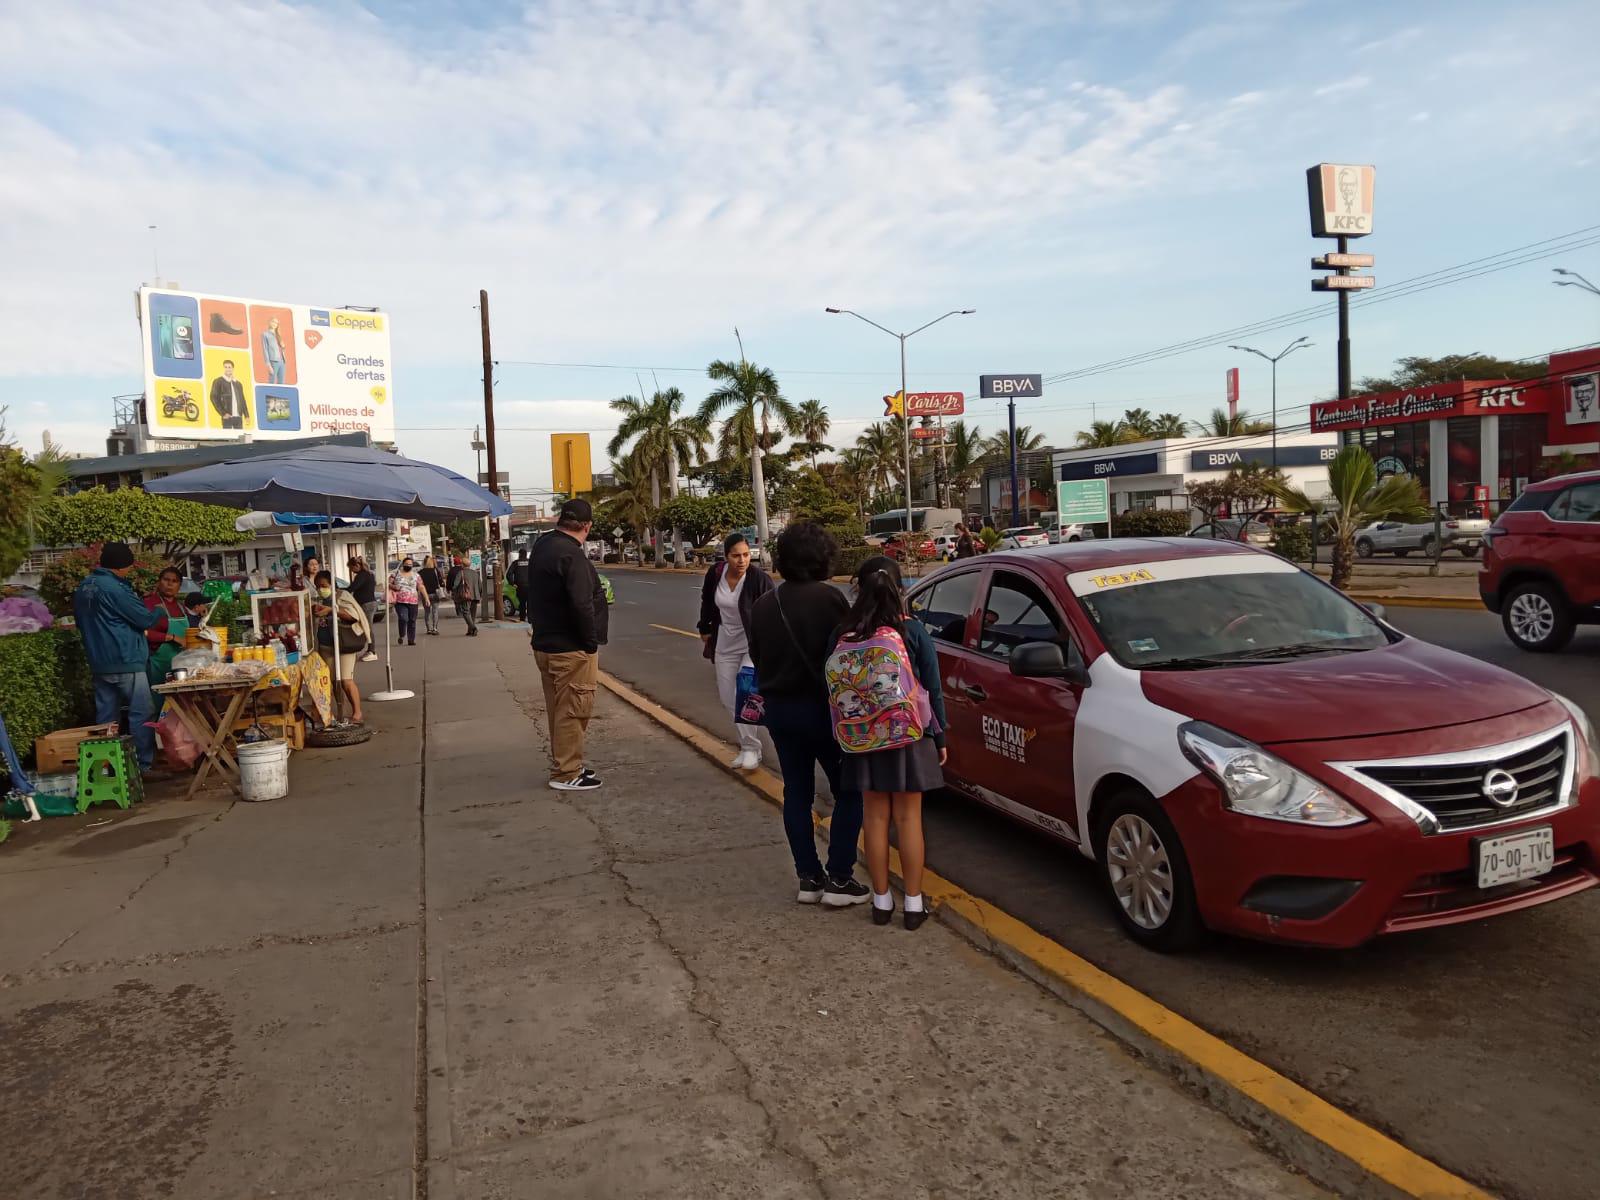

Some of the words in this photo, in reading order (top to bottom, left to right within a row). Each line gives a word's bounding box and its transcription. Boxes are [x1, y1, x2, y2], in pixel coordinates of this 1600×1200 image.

[1333, 215, 1365, 230] KFC
[336, 315, 377, 331] Coppel
[336, 353, 385, 368] Grandes
[346, 369, 385, 381] ofertas
[992, 377, 1034, 393] BBVA
[907, 394, 940, 410] Carl's
[1480, 387, 1527, 407] KFC
[309, 403, 358, 416] Millones
[360, 406, 375, 417] de
[1315, 404, 1366, 426] Kentucky
[1367, 399, 1400, 420] Fried
[1402, 393, 1454, 417] Chicken
[310, 419, 369, 433] productos
[1209, 451, 1242, 465] BBVA
[1094, 461, 1116, 474] BBVA
[1088, 568, 1156, 588] Taxi
[982, 714, 1001, 739] ECO
[1002, 721, 1025, 748] TAXI
[1483, 841, 1552, 873] 70-00-TVC
